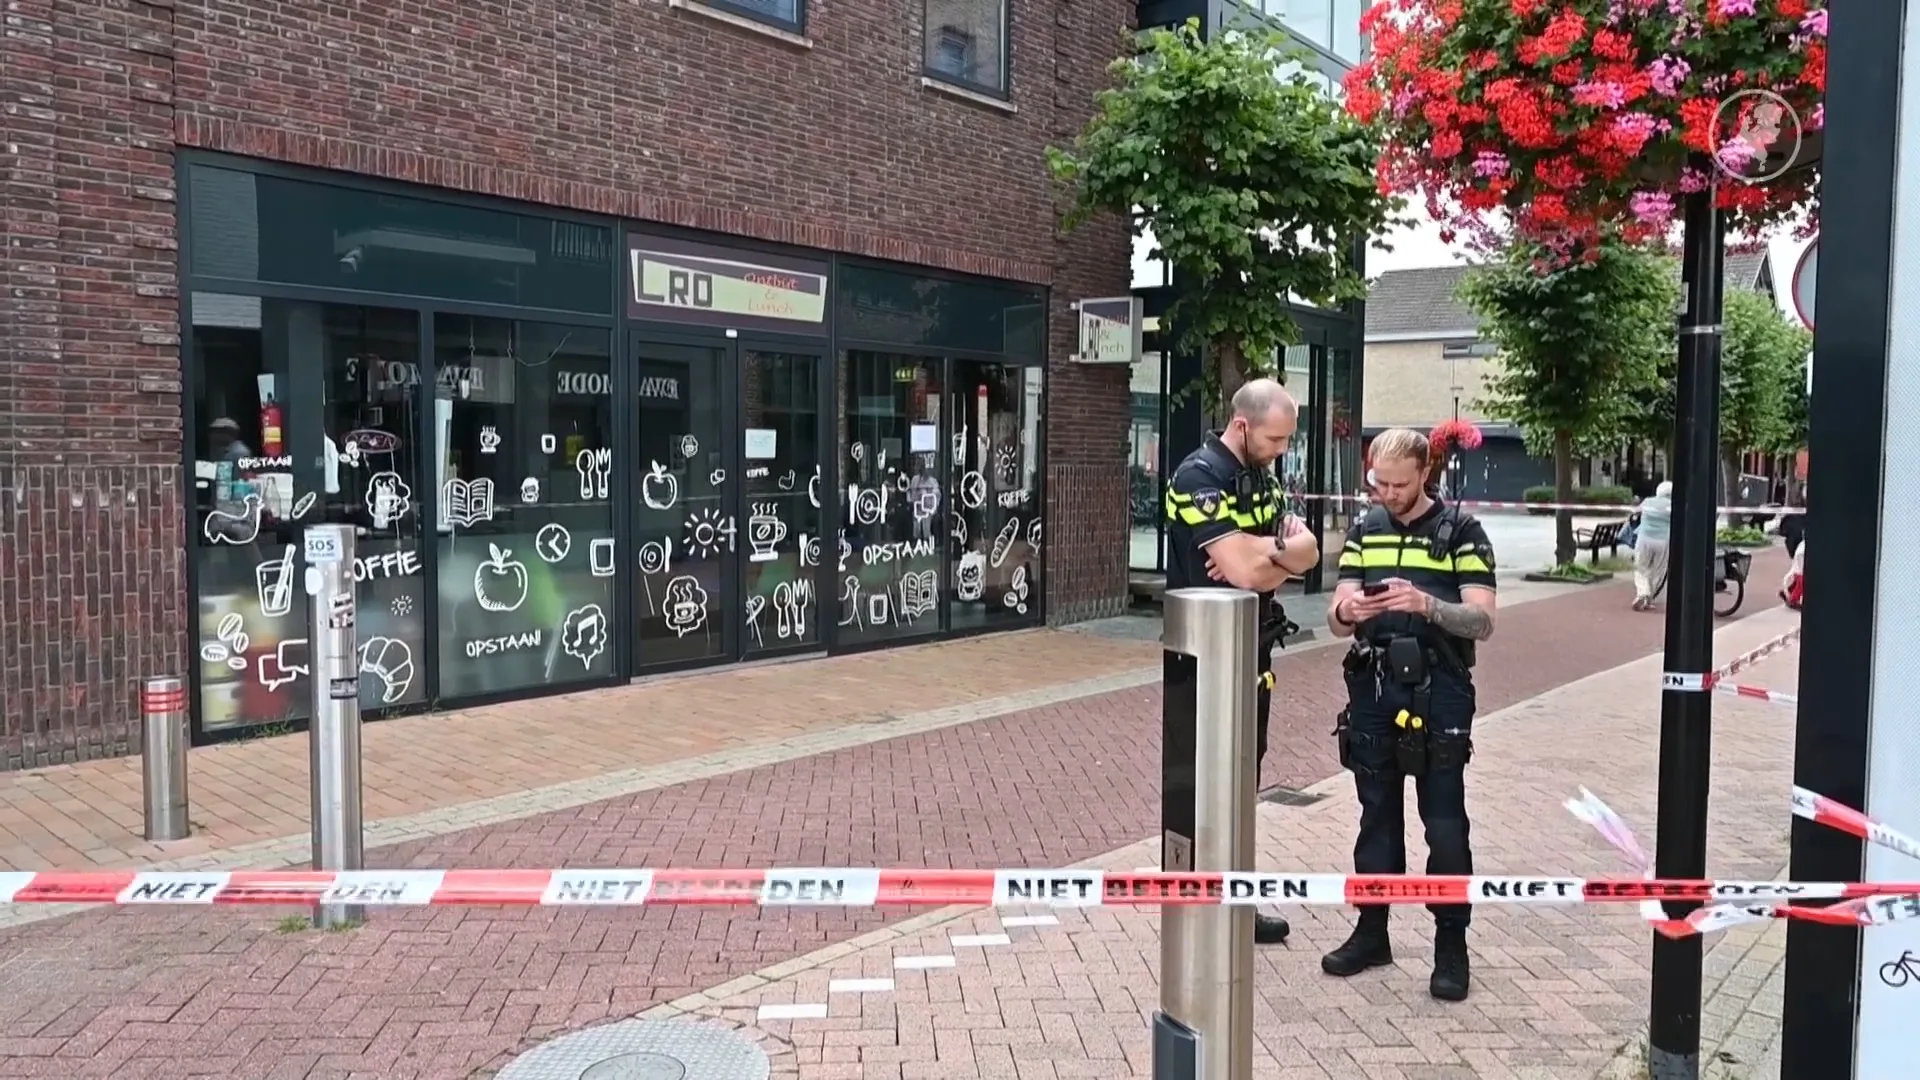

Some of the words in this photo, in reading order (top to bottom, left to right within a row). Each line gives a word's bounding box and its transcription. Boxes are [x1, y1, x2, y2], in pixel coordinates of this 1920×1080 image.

[308, 539, 335, 551] SOS
[353, 550, 422, 582] OFFIE
[131, 882, 218, 900] NIET
[557, 879, 643, 900] NIET
[1008, 879, 1093, 897] NIET
[1106, 879, 1308, 898] BETREDEN
